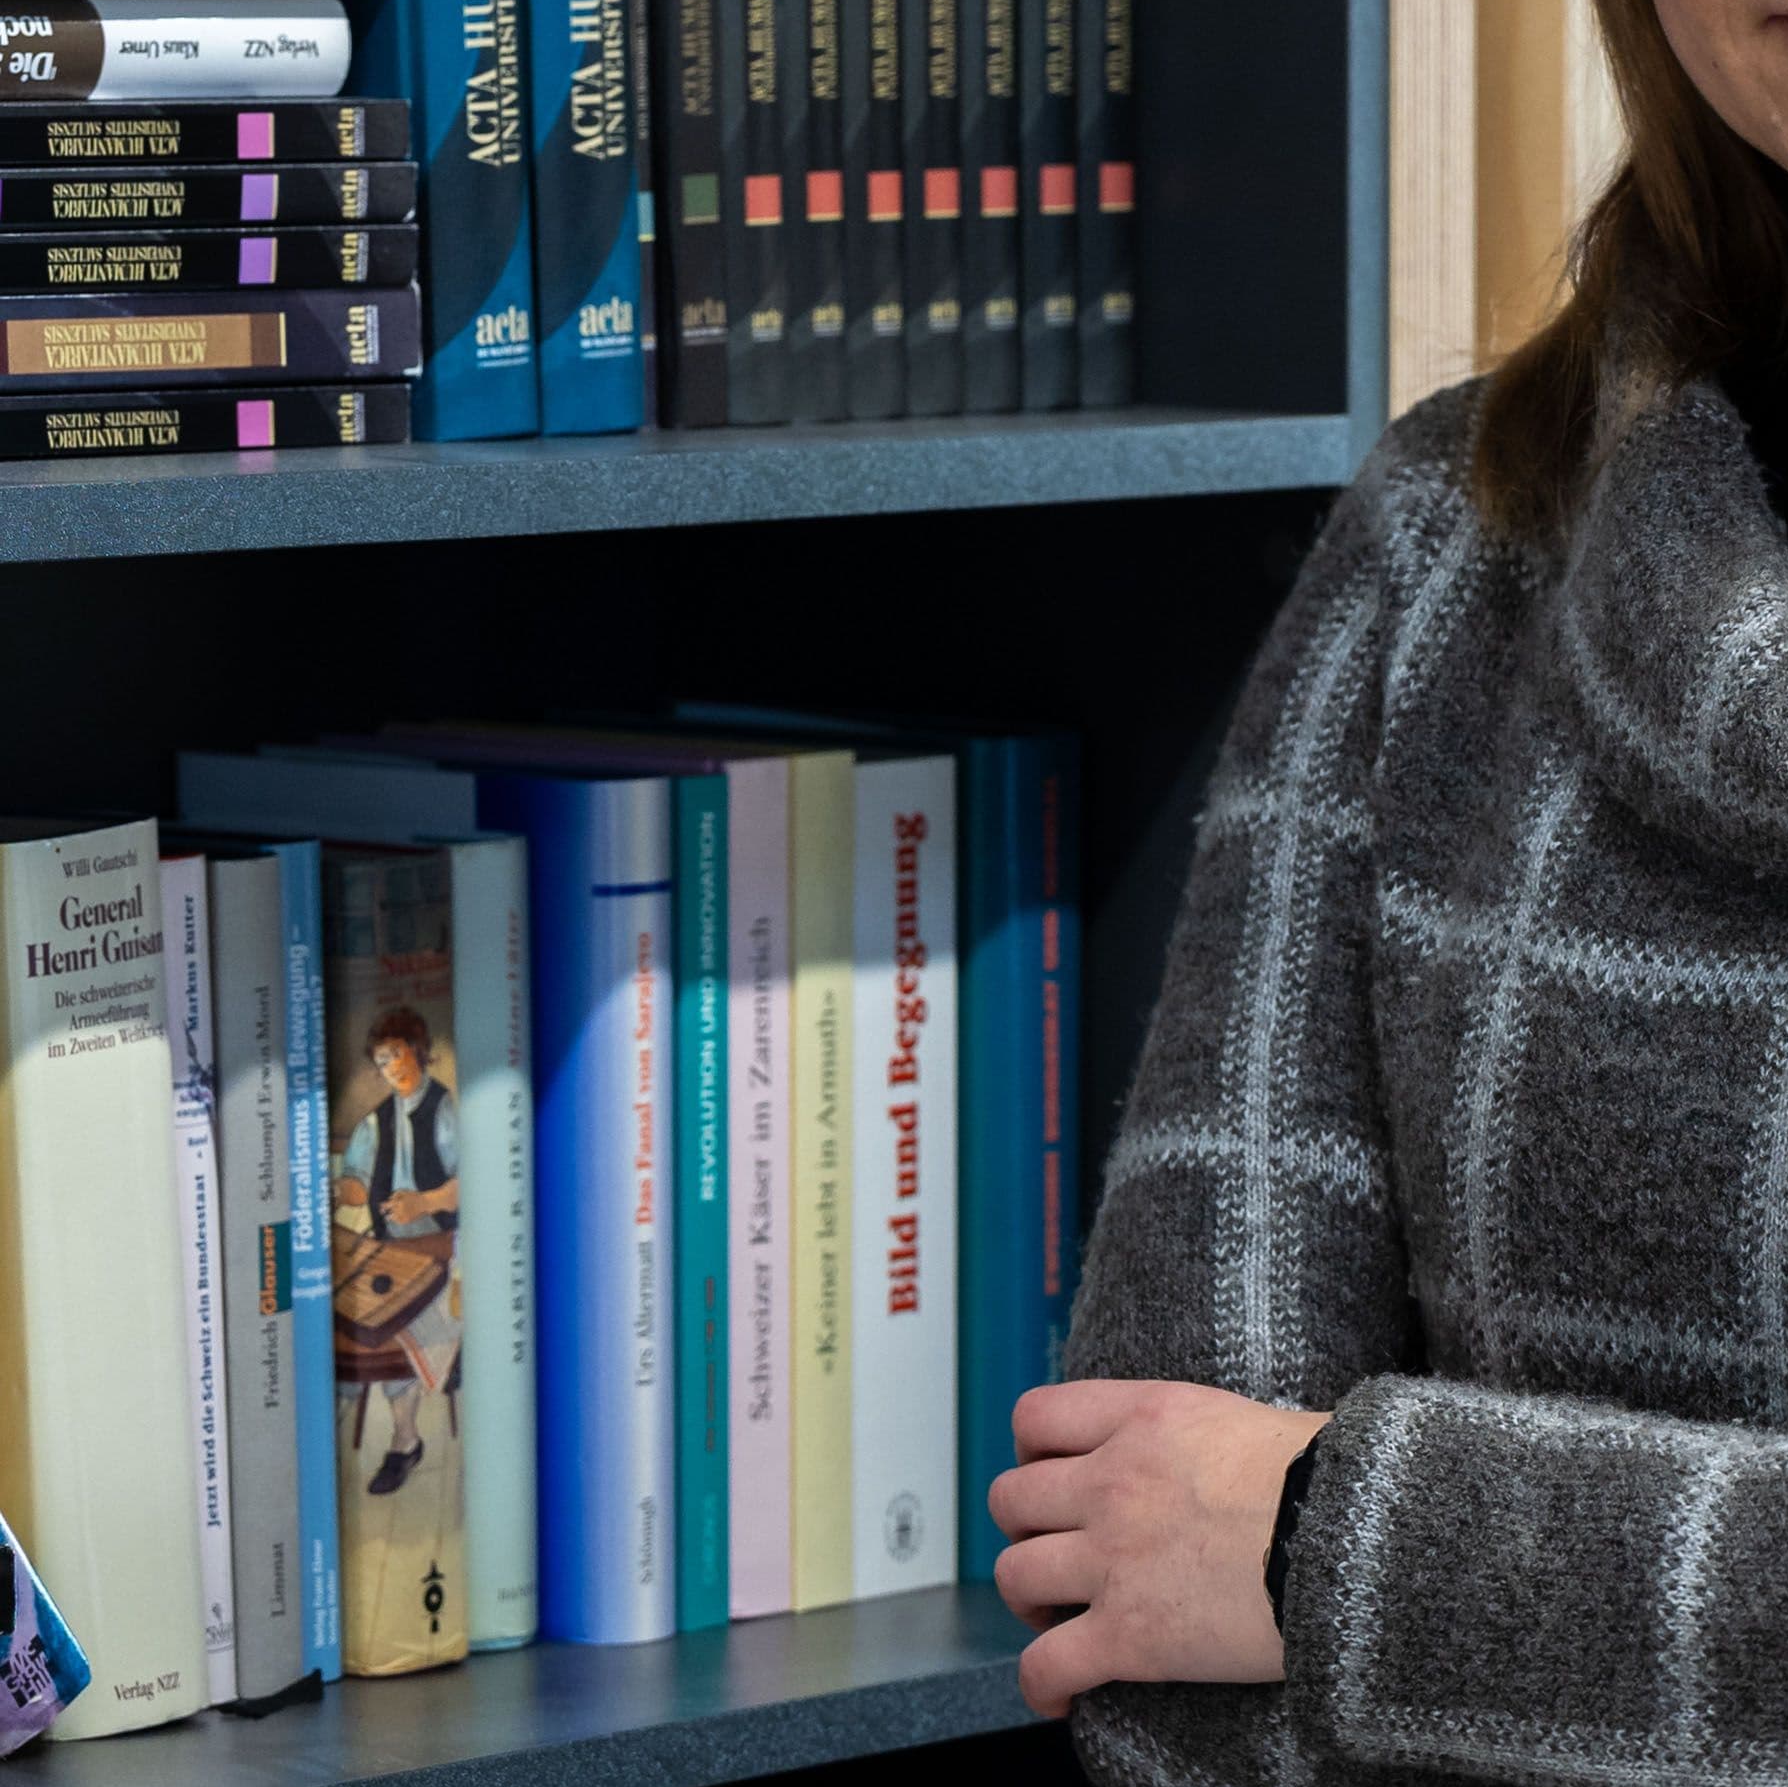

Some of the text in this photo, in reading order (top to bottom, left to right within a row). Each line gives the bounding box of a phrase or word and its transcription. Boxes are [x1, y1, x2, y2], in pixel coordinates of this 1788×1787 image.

[118, 38, 200, 60] Klaus Urner
[243, 34, 320, 60] Verlag NZZ
[337, 107, 355, 157] acta
[465, 67, 502, 167] ACTA
[570, 60, 607, 162] ACTA
[48, 137, 182, 157] ACTA HUMANITARICA
[52, 198, 186, 219] ACTA HUMANITARICA
[340, 169, 359, 220] acta
[47, 263, 182, 283] ACTA HUMANITARICA
[340, 232, 359, 282] acta
[346, 305, 367, 365] acta
[475, 304, 530, 347] acta
[579, 294, 634, 337] acta
[44, 341, 208, 369] ACTA HUMANITARICA
[46, 426, 180, 449] ACTA HUMANITARICA
[337, 393, 355, 443] acta
[62, 859, 91, 880] Willi
[60, 883, 144, 931] General
[26, 934, 98, 979] Henri
[54, 989, 78, 1010] Die
[185, 961, 201, 1032] Markus
[633, 932, 655, 1042] Sarajevo
[47, 1031, 116, 1060] im Zweiten
[886, 811, 928, 1316] Bild und Begegnung
[638, 1048, 655, 1093] von
[287, 943, 314, 1253] Föderalismus in Bewegung
[633, 1101, 655, 1170] Fanal
[747, 916, 773, 1424] Schweizer Käser im Zarenreich
[815, 1137, 839, 1239] lebt in
[255, 985, 281, 1409] Friedrich Glauser Schlumpf Erwin Mord
[634, 1177, 655, 1226] Das
[195, 1173, 222, 1528] Jetzt wird die Schweiz ein Bundesstaat
[113, 1671, 182, 1702] Verlag NZZ
